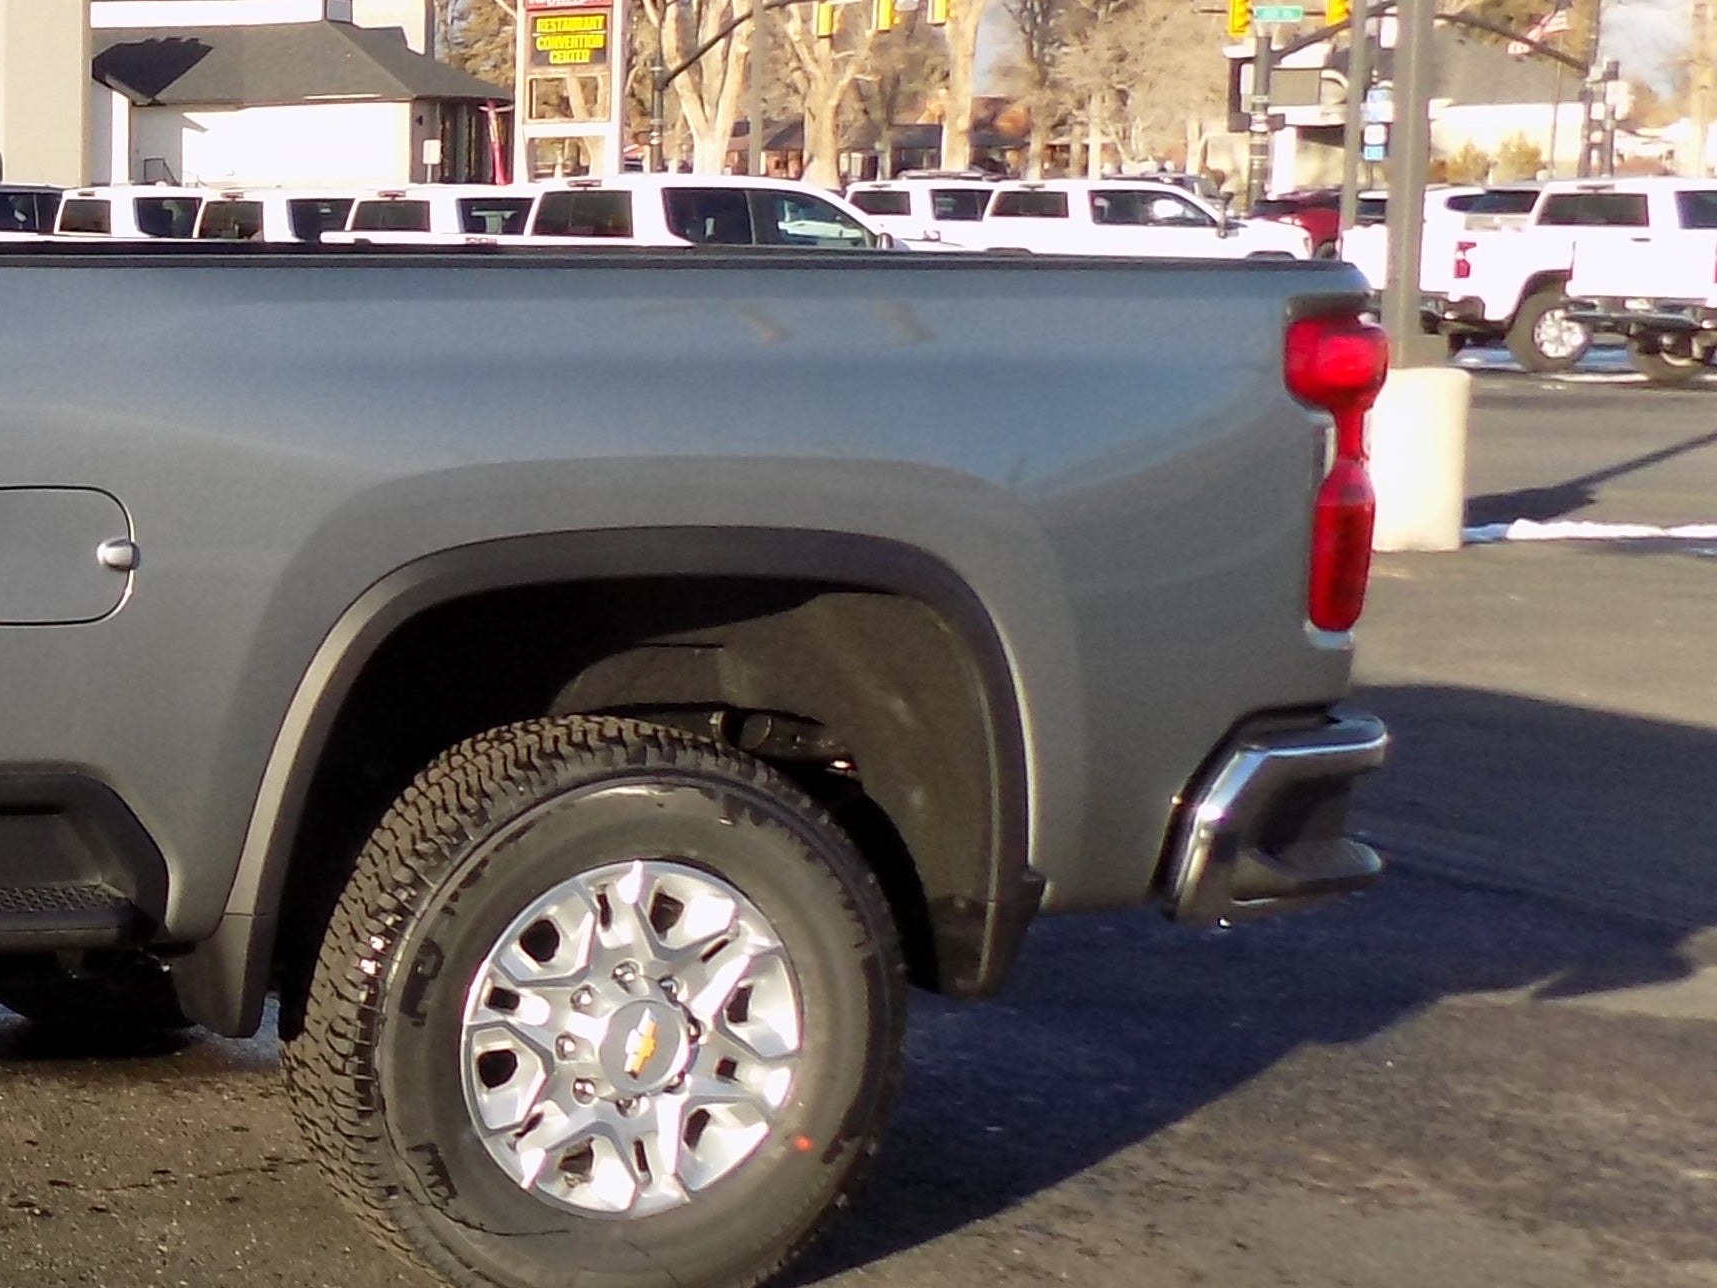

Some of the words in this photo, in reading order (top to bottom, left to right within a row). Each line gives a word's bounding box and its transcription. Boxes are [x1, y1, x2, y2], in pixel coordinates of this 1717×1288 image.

[536, 16, 605, 32] RESTAURANT
[536, 34, 604, 50] CONVENTION
[549, 49, 589, 64] CENTER
